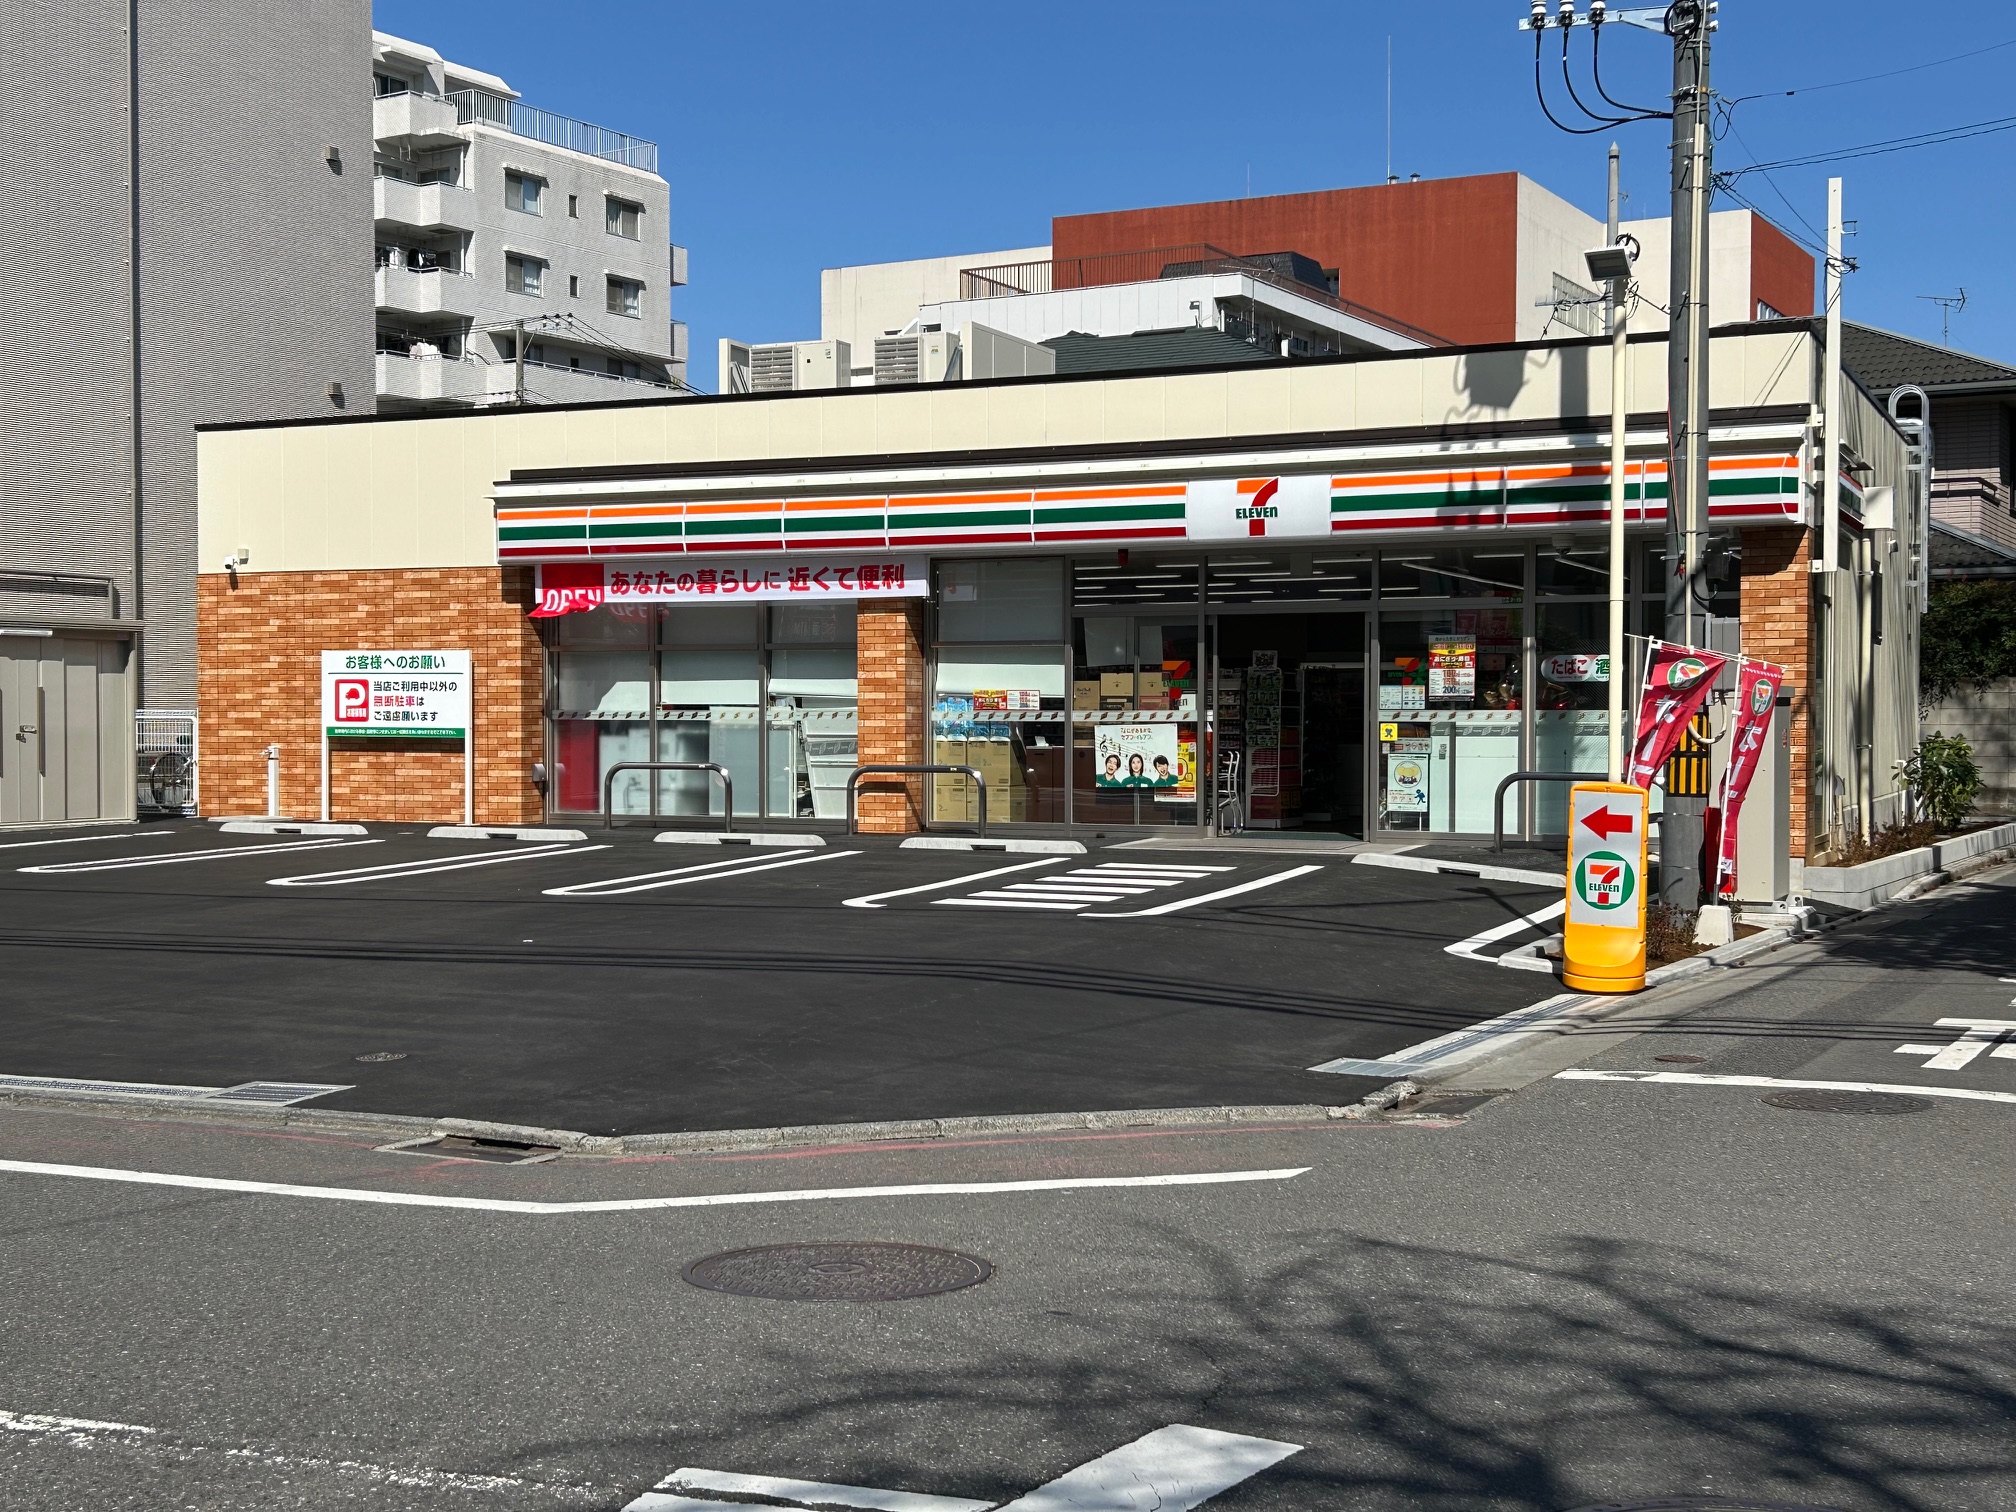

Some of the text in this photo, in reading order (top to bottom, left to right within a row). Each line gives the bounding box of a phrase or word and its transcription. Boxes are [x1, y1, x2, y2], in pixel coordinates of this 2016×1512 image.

[611, 563, 905, 596] あなたの暮らしに 近くて便利
[345, 655, 446, 670] お客様へのお願い
[1551, 658, 1588, 675] たばこ
[373, 680, 458, 692] 当店ご利用中以外の
[373, 695, 425, 707] 無断駐車は
[373, 711, 439, 722] ご遠慮願います
